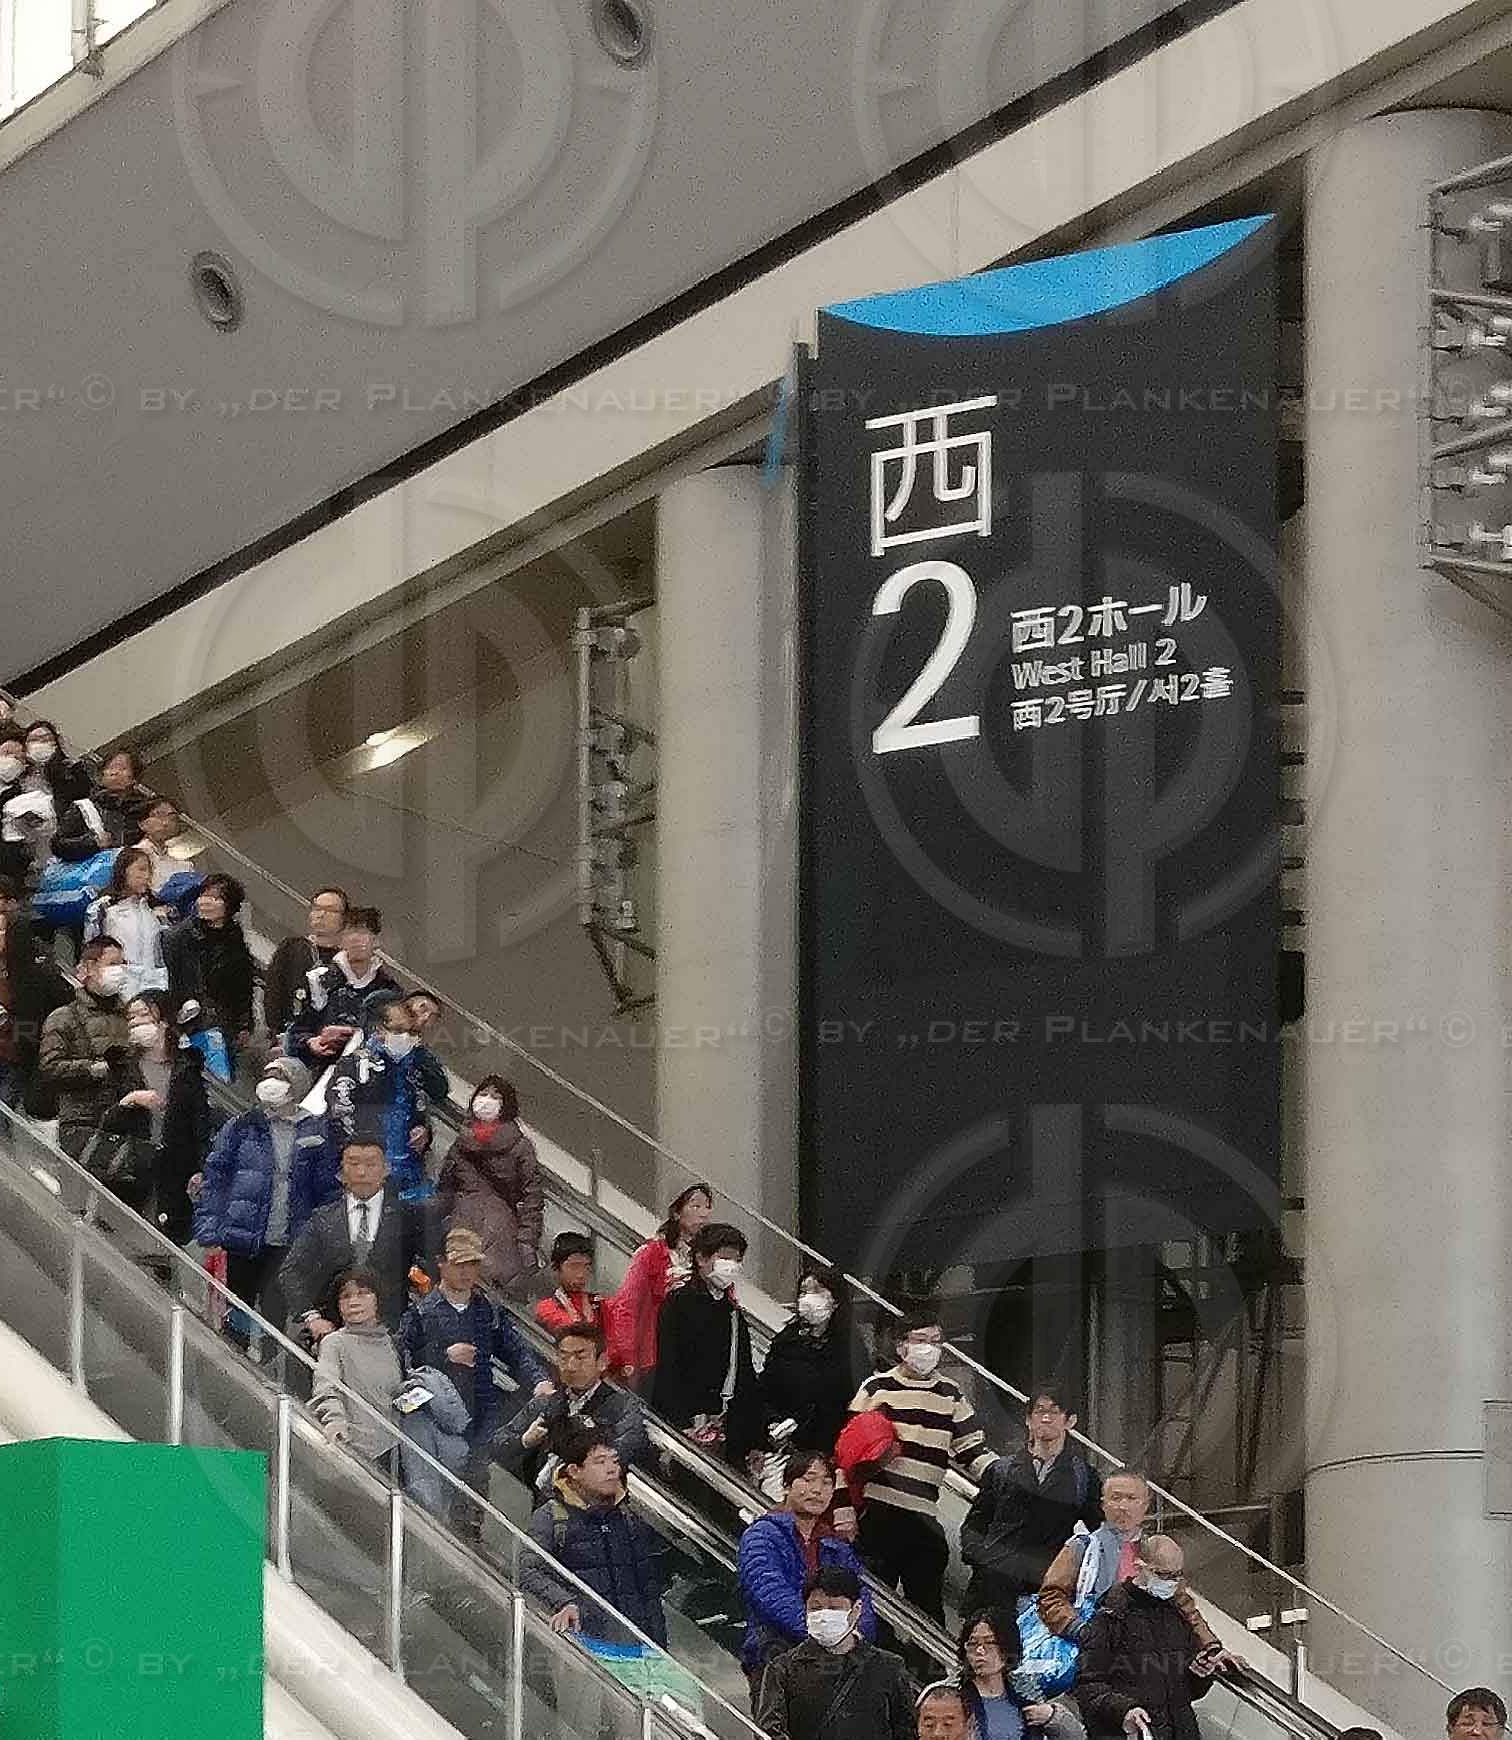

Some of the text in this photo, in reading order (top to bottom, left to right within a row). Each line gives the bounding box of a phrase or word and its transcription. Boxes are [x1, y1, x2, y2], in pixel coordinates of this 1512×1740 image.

[865, 395, 998, 556] 西
[872, 561, 980, 754] 2
[1010, 582, 1208, 653] 西2ホール
[1011, 638, 1177, 689] West Hall 2
